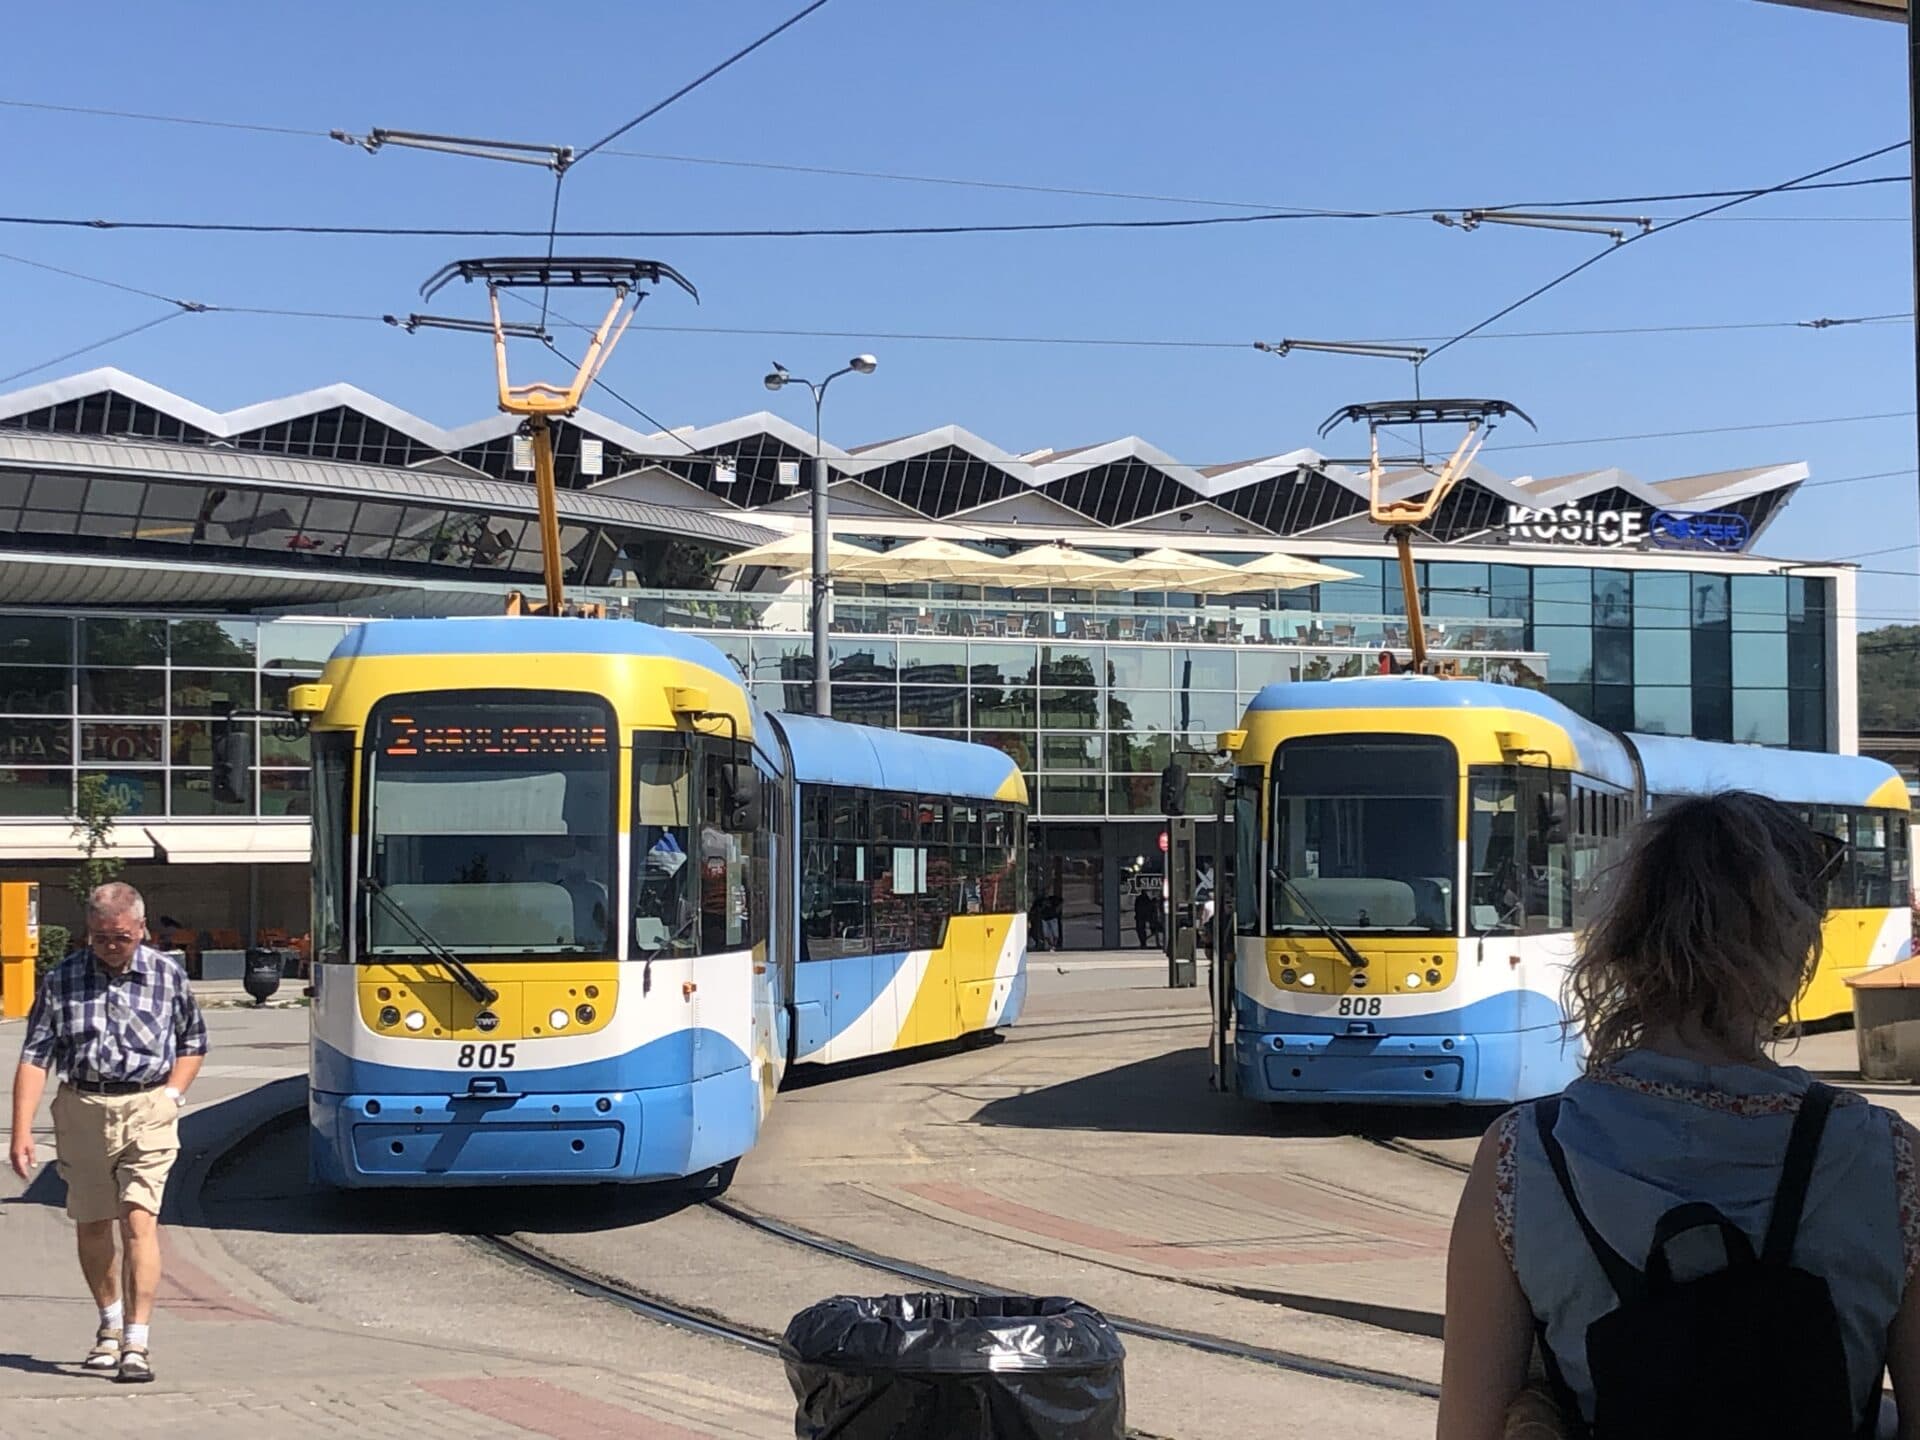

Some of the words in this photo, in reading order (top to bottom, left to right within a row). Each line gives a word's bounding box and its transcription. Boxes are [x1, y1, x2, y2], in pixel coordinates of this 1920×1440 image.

[1508, 500, 1642, 543] KOŠICE
[9, 736, 162, 762] FASHION
[1338, 996, 1382, 1016] 808
[457, 1043, 517, 1069] 805
